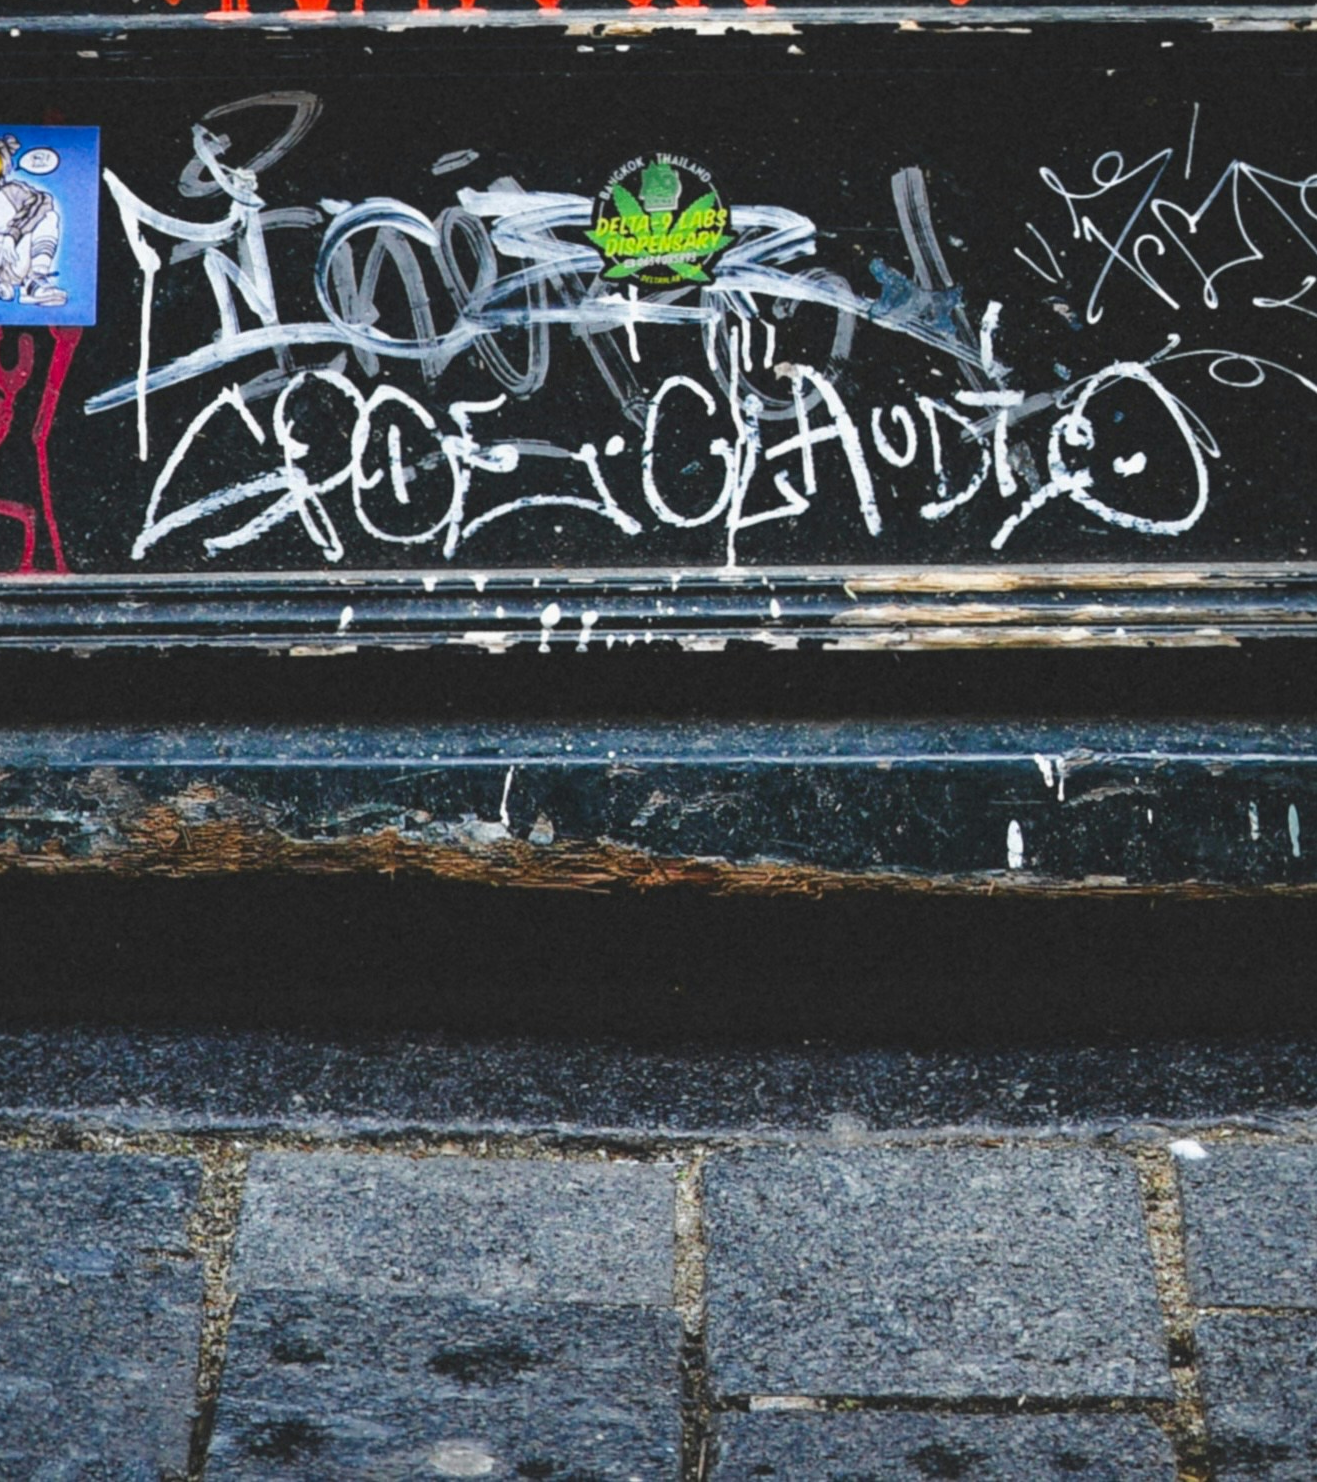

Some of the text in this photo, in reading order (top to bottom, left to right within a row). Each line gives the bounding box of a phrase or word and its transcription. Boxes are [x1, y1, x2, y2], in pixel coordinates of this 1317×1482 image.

[599, 152, 712, 201] BANGKOK THAILAND
[595, 209, 727, 236] DELTA-9 LABS
[605, 231, 721, 256] DISPENSARY
